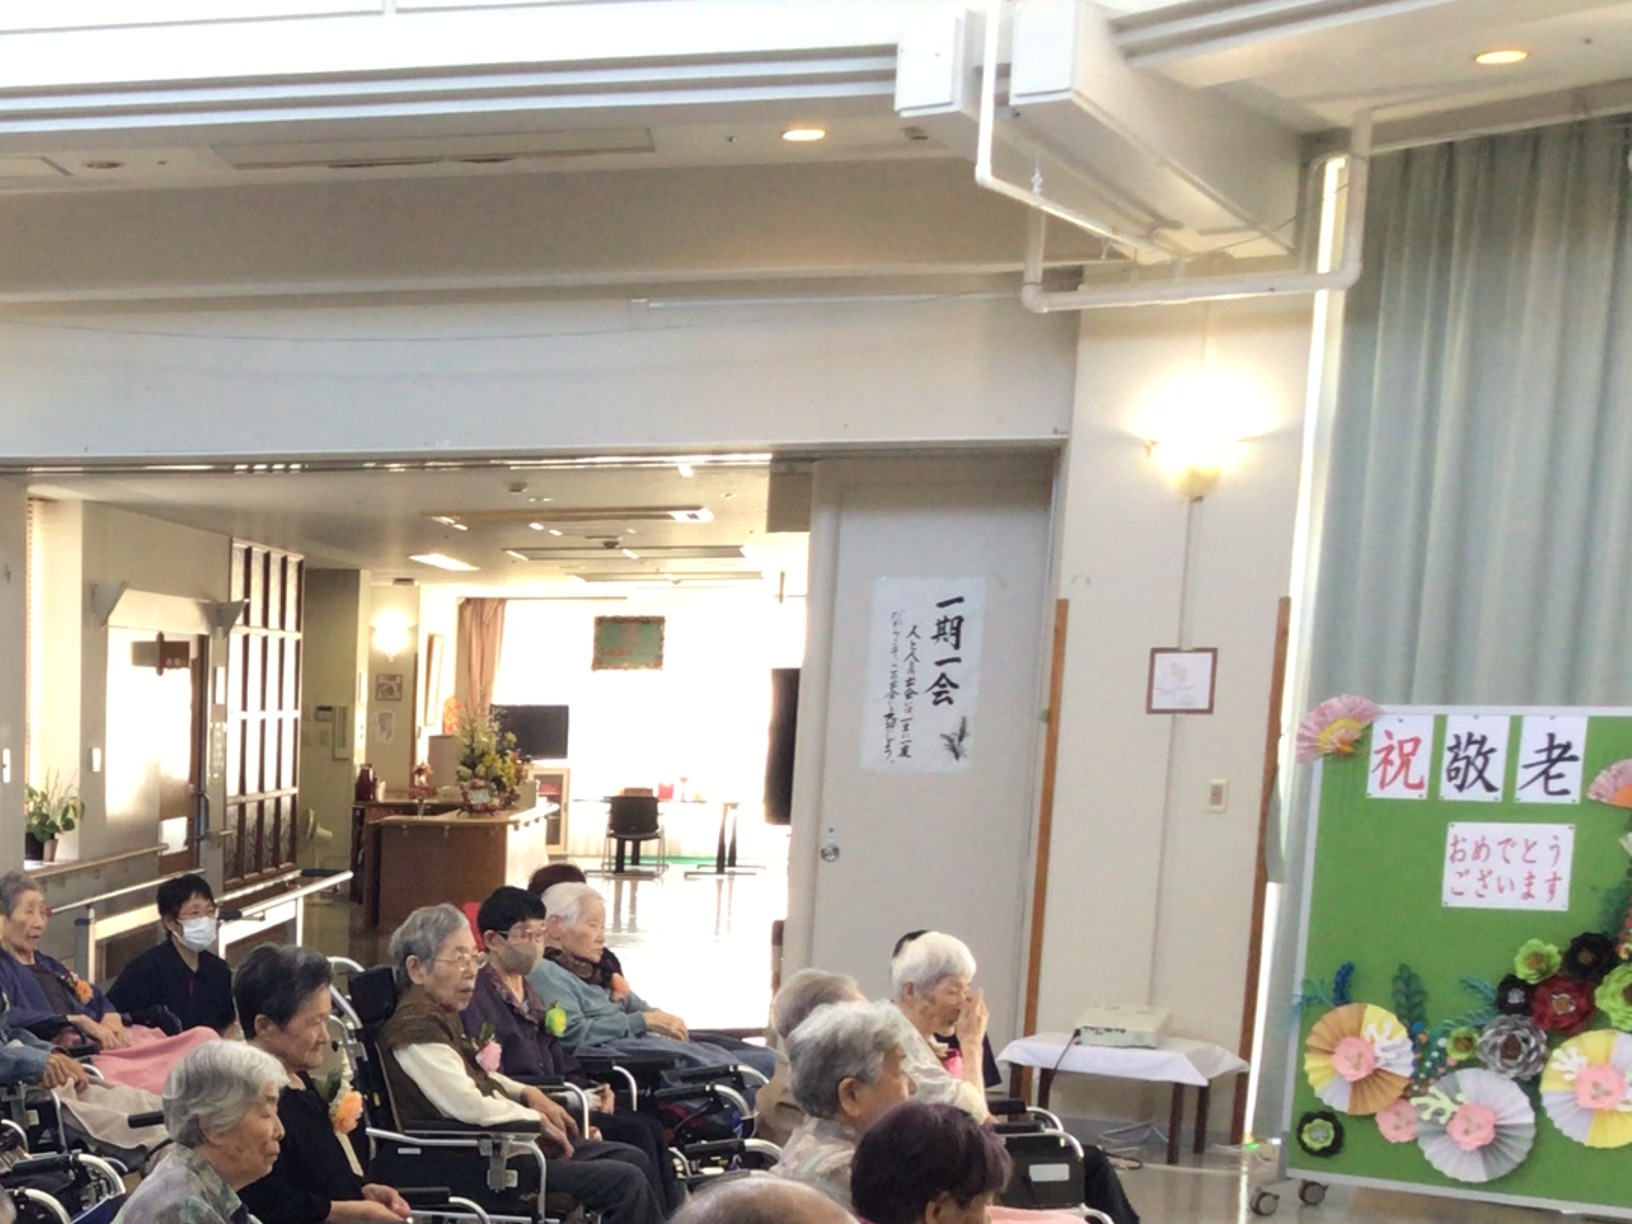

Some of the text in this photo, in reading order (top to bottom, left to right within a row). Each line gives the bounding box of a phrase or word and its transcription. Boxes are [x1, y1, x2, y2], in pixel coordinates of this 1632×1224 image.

[924, 595, 966, 707] 一期一会
[1449, 834, 1562, 866] おめでとう
[1450, 869, 1563, 903] ございます
